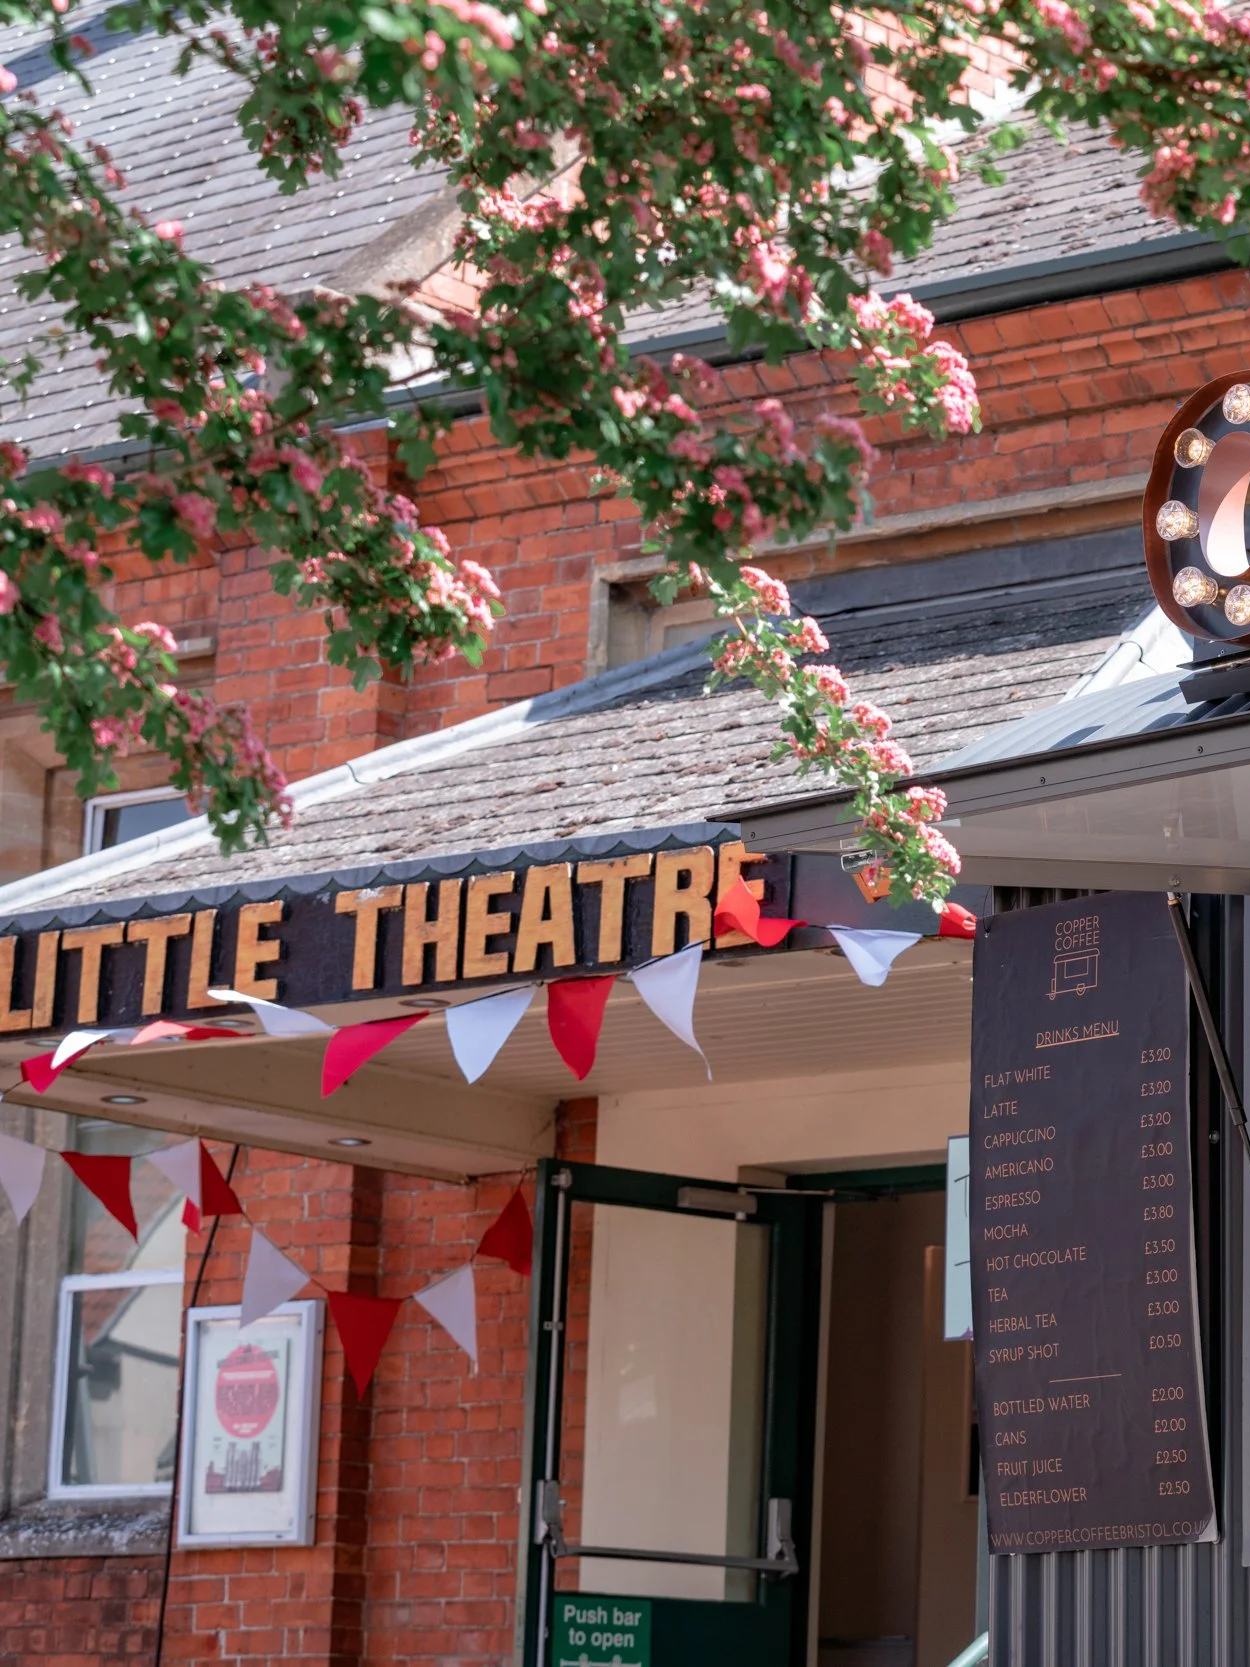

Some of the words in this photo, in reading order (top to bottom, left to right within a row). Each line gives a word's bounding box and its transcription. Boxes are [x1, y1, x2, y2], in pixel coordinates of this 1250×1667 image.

[0, 900, 284, 1032] LITTLE
[335, 840, 769, 992] THEATRE
[1055, 915, 1100, 936] COPPER
[1055, 931, 1100, 950] COFFEE
[1036, 1027, 1079, 1046] DRINKS
[1082, 1020, 1119, 1038] MENU
[984, 1070, 1011, 1088] FLAT
[1014, 1064, 1051, 1082] WHITE
[1141, 1048, 1171, 1063] £3.20
[983, 1100, 1018, 1119] LATTE
[1141, 1080, 1171, 1096] £3.20
[984, 1126, 1056, 1150] CAPPUCCINO
[1141, 1112, 1171, 1128] £3.20
[984, 1157, 1054, 1180] AMERICANO
[1141, 1142, 1173, 1158] £3.00
[985, 1190, 1041, 1210] ESPRESSO
[1143, 1174, 1174, 1190] £3.00
[984, 1223, 1028, 1241] MOCHA
[1144, 1205, 1173, 1220] £3.80
[986, 1254, 1011, 1273] HOT
[1014, 1246, 1087, 1269] CHOCOLATE
[1144, 1239, 1175, 1255] £3.50
[988, 1288, 1009, 1303] TEA
[1146, 1269, 1178, 1285] £3.00
[989, 1315, 1031, 1333] HERBAL
[1036, 1313, 1057, 1329] TEA
[1148, 1300, 1179, 1316] £3.00
[989, 1347, 1024, 1364] SYRUP
[1028, 1343, 1059, 1360] SHOT
[1149, 1333, 1182, 1349] £0.50
[993, 1397, 1045, 1417] BOTTLED
[1049, 1394, 1090, 1412] WATER
[1152, 1387, 1184, 1403] £2.00
[995, 1430, 1027, 1447] CANS
[1154, 1418, 1186, 1433] £2.00
[997, 1462, 1028, 1477] FRUIT
[1033, 1458, 1063, 1475] JUICE
[1156, 1450, 1187, 1464] £2.50
[1000, 1487, 1087, 1507] ELDERFLOWER
[1159, 1481, 1190, 1496] £2.50
[564, 1604, 608, 1625] Push
[613, 1606, 642, 1626] bar
[568, 1627, 586, 1646] to
[591, 1631, 635, 1652] open
